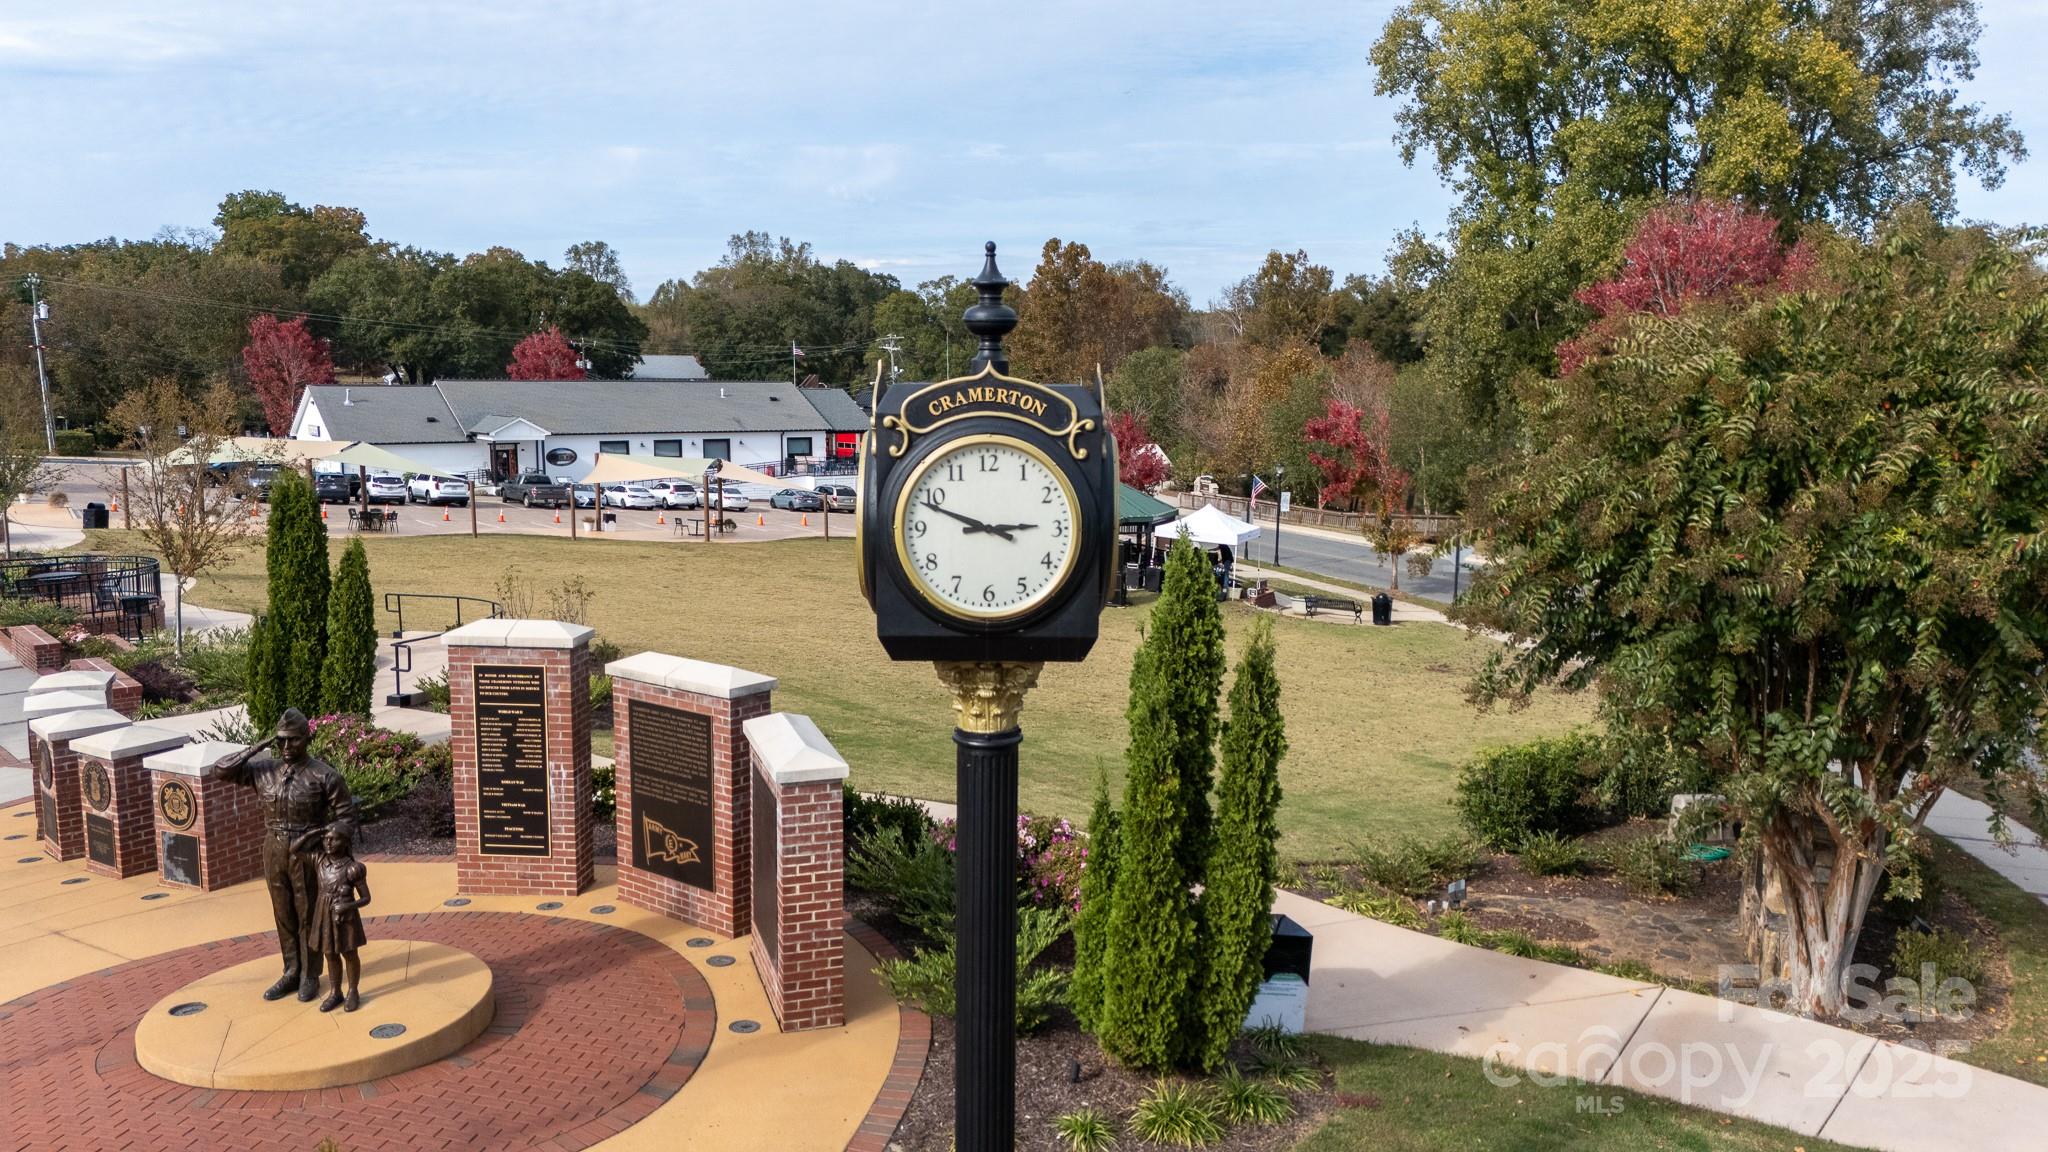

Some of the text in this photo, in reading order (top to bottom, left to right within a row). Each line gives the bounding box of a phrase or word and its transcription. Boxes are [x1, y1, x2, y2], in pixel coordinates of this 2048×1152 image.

[928, 386, 1047, 416] CRAMERTON
[947, 463, 965, 481] 11
[979, 454, 999, 472] 12
[1019, 463, 1027, 481] 1
[926, 487, 945, 506] 10
[1041, 486, 1053, 504] 2
[914, 520, 927, 538] 9
[1052, 520, 1063, 537] 3
[925, 553, 938, 570] 8
[1041, 552, 1053, 569] 4
[951, 576, 962, 593] 7
[983, 585, 995, 602] 6
[1016, 577, 1027, 594] 5
